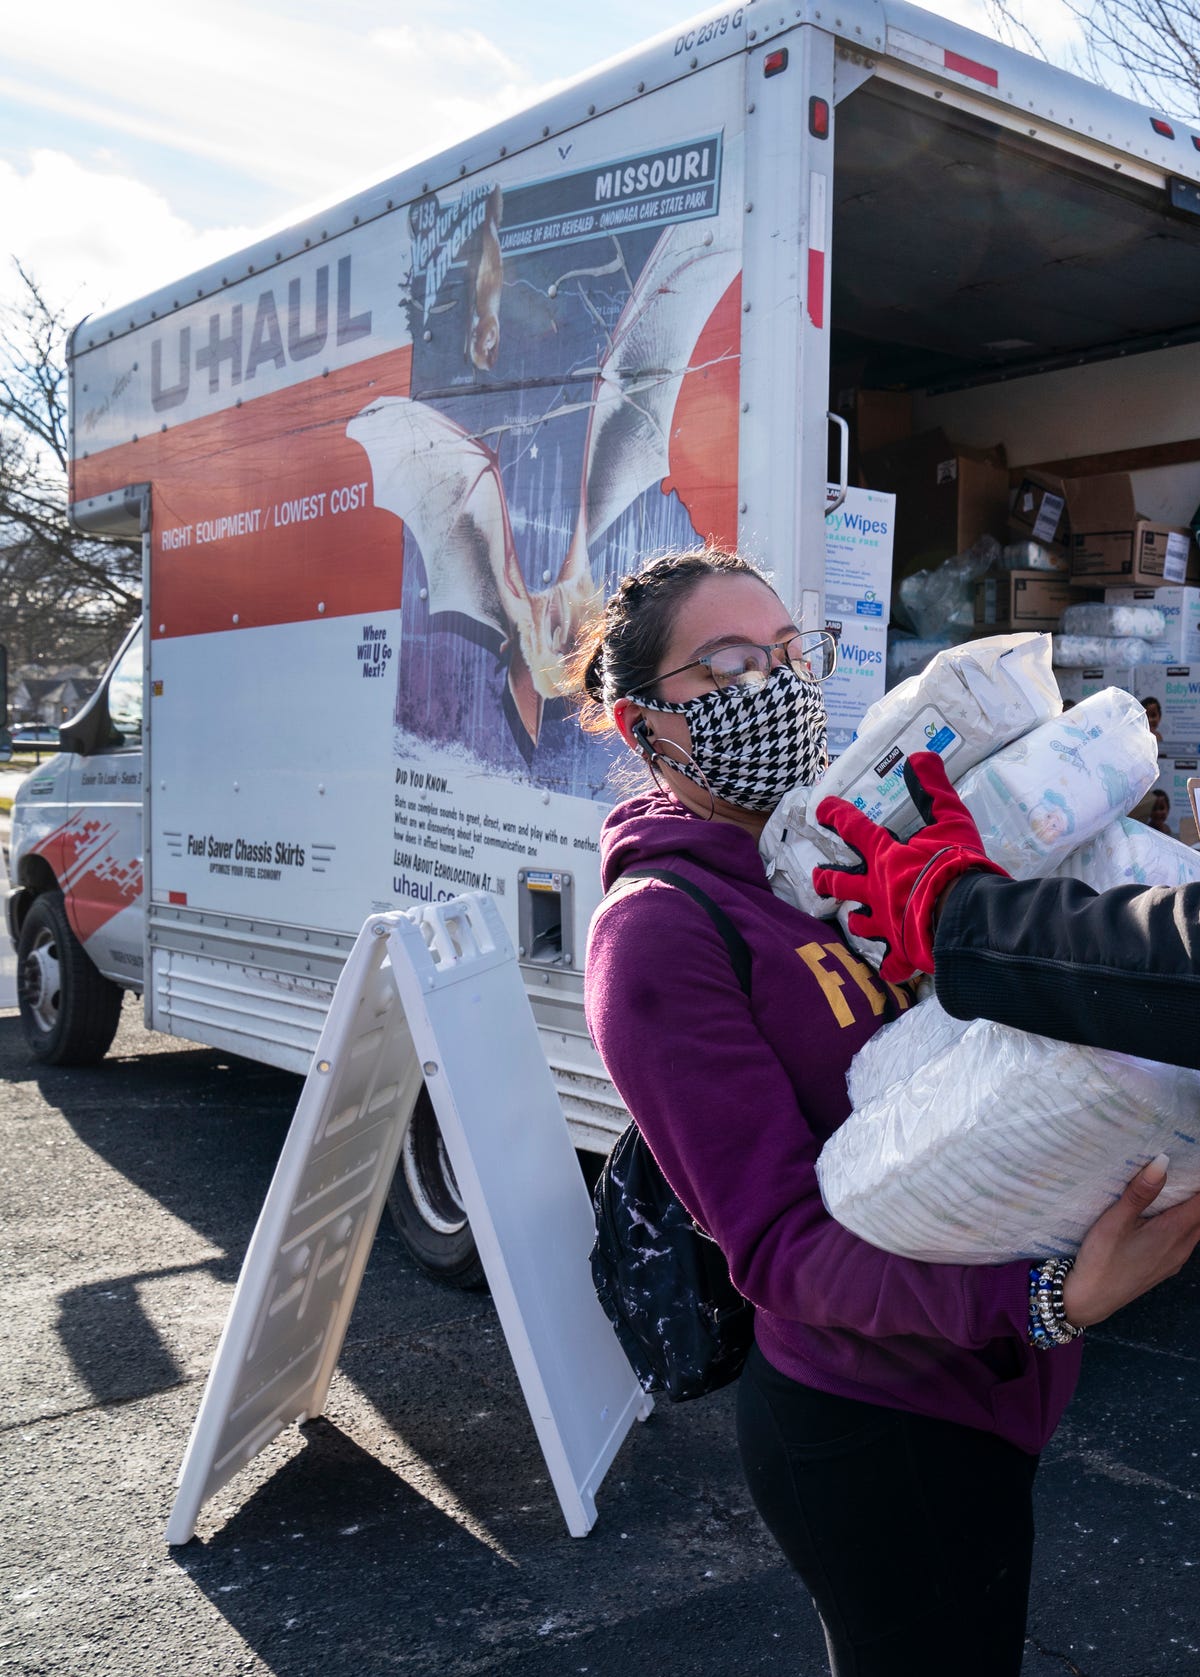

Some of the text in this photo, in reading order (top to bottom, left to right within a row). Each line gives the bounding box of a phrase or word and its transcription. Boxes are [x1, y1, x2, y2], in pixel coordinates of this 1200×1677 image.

[674, 8, 743, 56] DC 2379 G
[595, 148, 710, 201] MISSOURI
[411, 201, 460, 278] Venture
[501, 229, 533, 250] LANGUAGE
[534, 227, 542, 240] OF
[543, 223, 560, 240] BATS
[561, 216, 594, 236] REVEALED
[600, 209, 638, 228] ONONDAGA
[639, 203, 659, 219] CAVE
[660, 197, 684, 216] STATE
[684, 190, 707, 210] PARK
[424, 200, 487, 327] America
[151, 254, 372, 414] U-HAUL
[161, 525, 192, 551] RIGHT
[196, 509, 261, 545] EQUIPMENT
[274, 493, 326, 527] LOWEST
[330, 482, 368, 514] COST
[357, 643, 392, 664] Will U Go
[363, 625, 387, 641] Where
[363, 661, 386, 678] Next?
[395, 768, 408, 785] DID
[410, 768, 425, 788] YOU
[876, 748, 900, 773] KIRKLAND
[395, 794, 407, 808] Bats
[408, 801, 416, 811] use
[440, 807, 457, 820] sounds
[459, 810, 464, 822] to
[518, 823, 529, 836] and
[531, 825, 543, 842] play
[545, 828, 558, 843] with
[395, 812, 408, 825] What
[409, 818, 417, 828] are
[418, 821, 425, 830] we
[427, 819, 455, 840] discovering
[457, 826, 471, 840] about
[473, 829, 482, 843] bat
[484, 835, 526, 854] communication
[187, 834, 206, 856] Fuel
[235, 838, 272, 863] Chassis
[275, 842, 305, 867] Skirts
[393, 827, 404, 841] how
[405, 831, 416, 845] does
[440, 838, 457, 854] human
[459, 843, 475, 859] lives?
[209, 862, 282, 881] OPTIMIZE YOUR FUEL ECONOMY
[393, 849, 412, 869] LEARN
[413, 853, 433, 875] ABOUT
[434, 860, 481, 889] ECHOLOCATION
